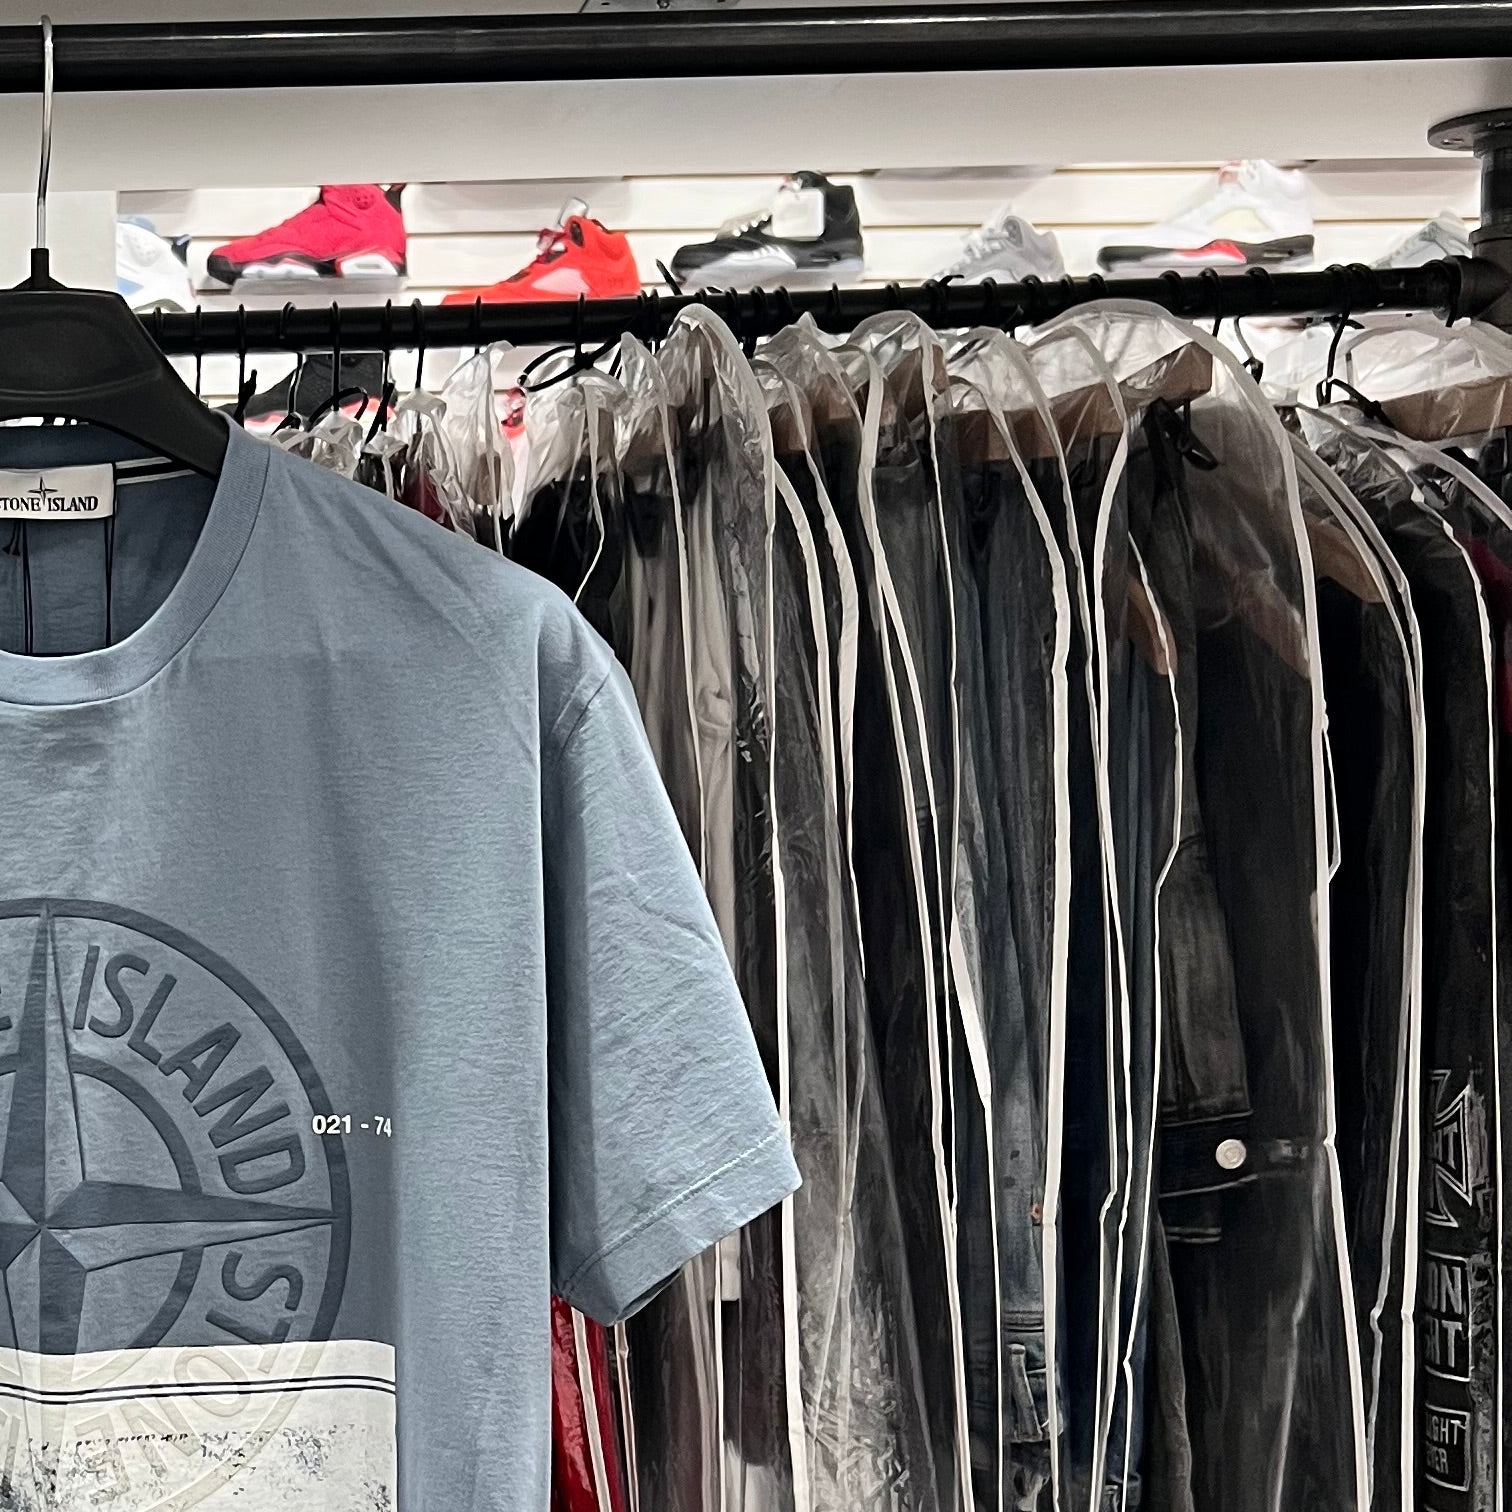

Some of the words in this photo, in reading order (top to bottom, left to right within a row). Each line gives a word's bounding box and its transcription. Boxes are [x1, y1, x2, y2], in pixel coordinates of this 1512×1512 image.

[48, 496, 99, 512] ISLAND
[73, 945, 306, 1195] ISLAND
[312, 1114, 351, 1135] 021
[374, 1115, 392, 1138] 74
[75, 1250, 304, 1505] STONE
